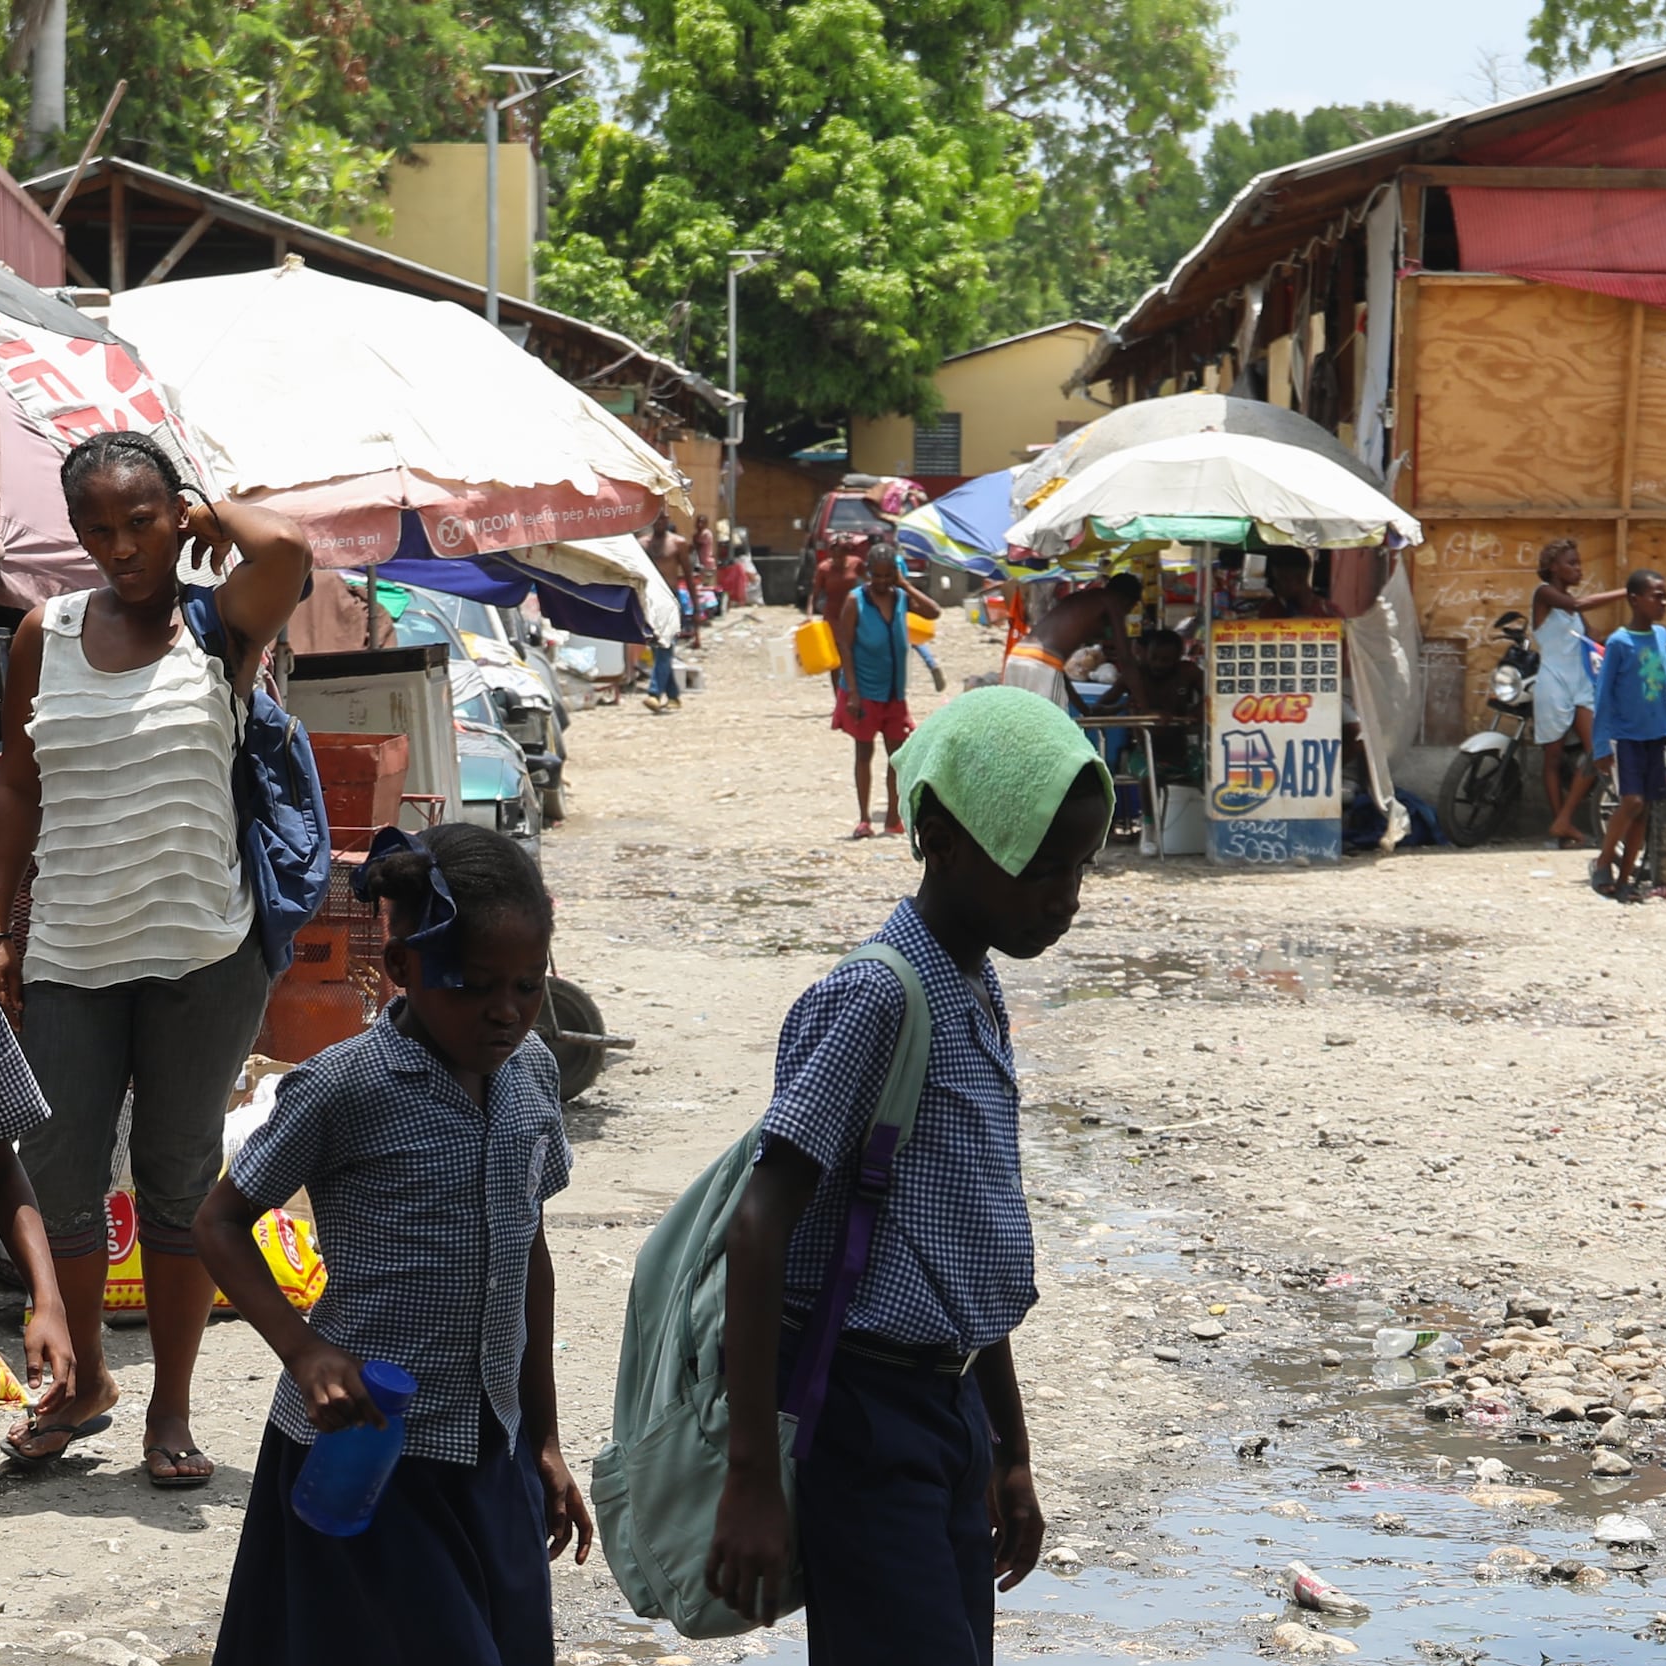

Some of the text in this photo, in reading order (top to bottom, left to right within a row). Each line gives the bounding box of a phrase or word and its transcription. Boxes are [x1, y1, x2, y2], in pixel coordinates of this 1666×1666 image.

[588, 503, 633, 520] Ayisyen
[308, 532, 382, 550] yisyen an!
[1212, 729, 1343, 817] BABY
